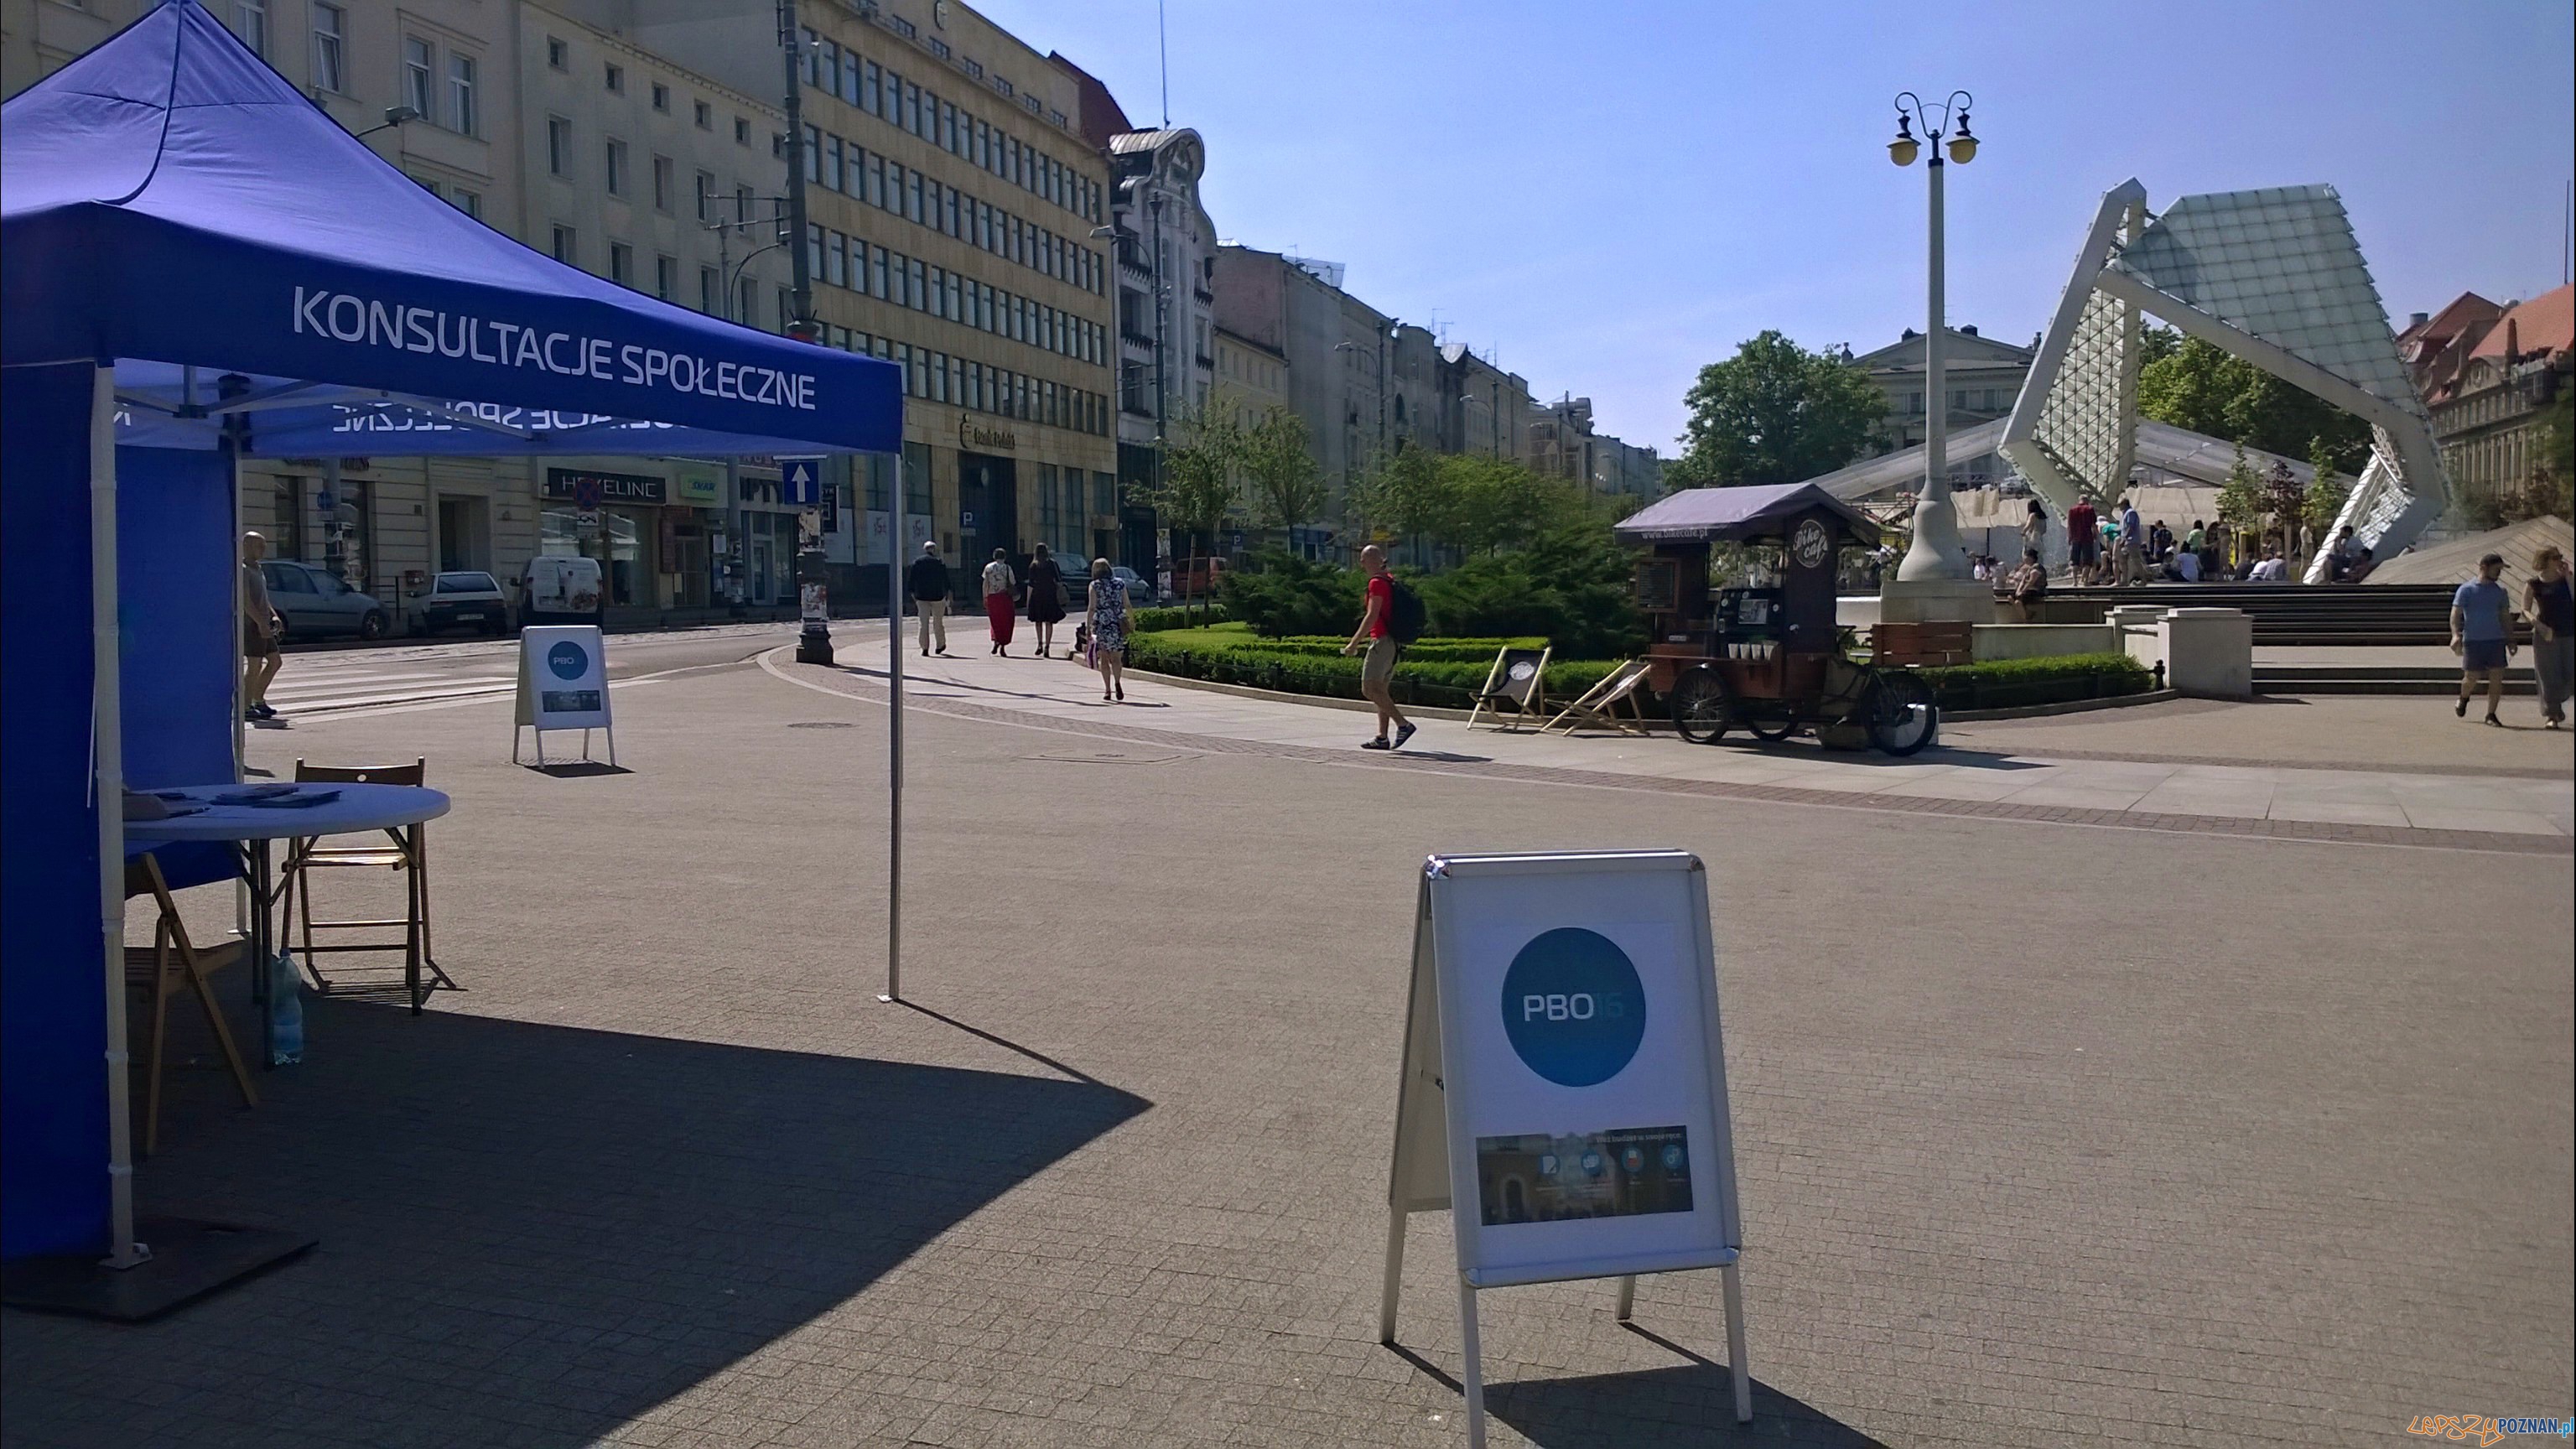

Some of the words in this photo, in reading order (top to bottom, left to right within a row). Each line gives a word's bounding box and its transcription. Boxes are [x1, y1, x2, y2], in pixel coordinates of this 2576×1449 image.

[293, 285, 614, 380] KONSULTACJE
[622, 344, 817, 411] SPOŁECZNE
[963, 512, 974, 526] P
